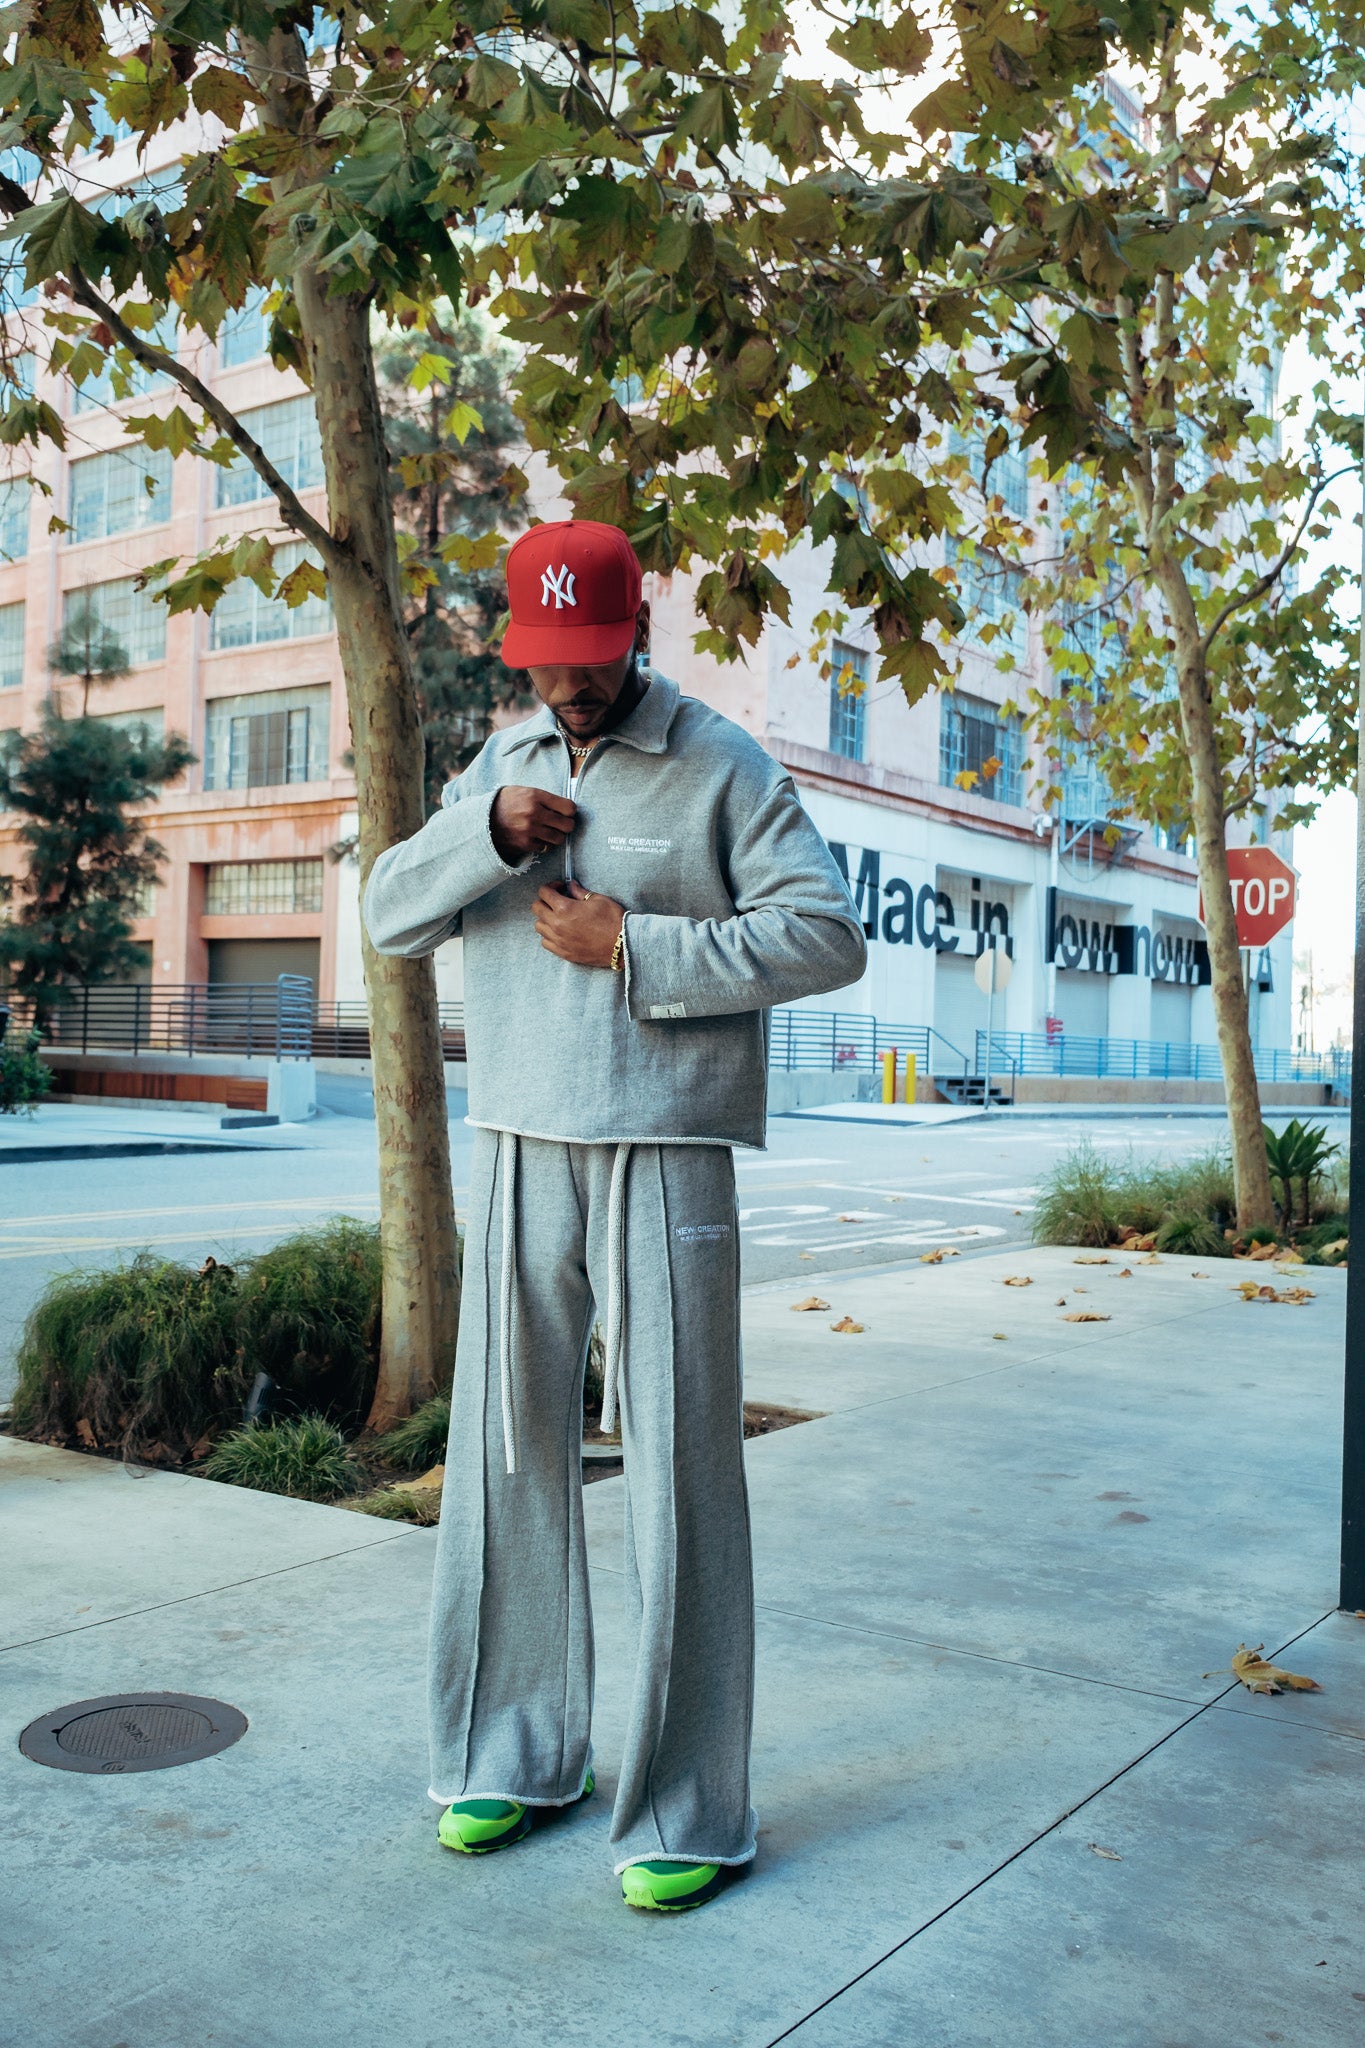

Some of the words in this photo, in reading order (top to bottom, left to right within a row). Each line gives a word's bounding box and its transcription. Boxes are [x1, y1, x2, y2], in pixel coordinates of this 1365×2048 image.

[607, 836, 626, 844] NEW
[628, 838, 671, 847] CREATION
[1229, 878, 1290, 916] TOP
[675, 1226, 695, 1237] NEW
[697, 1224, 730, 1233] CREATION
